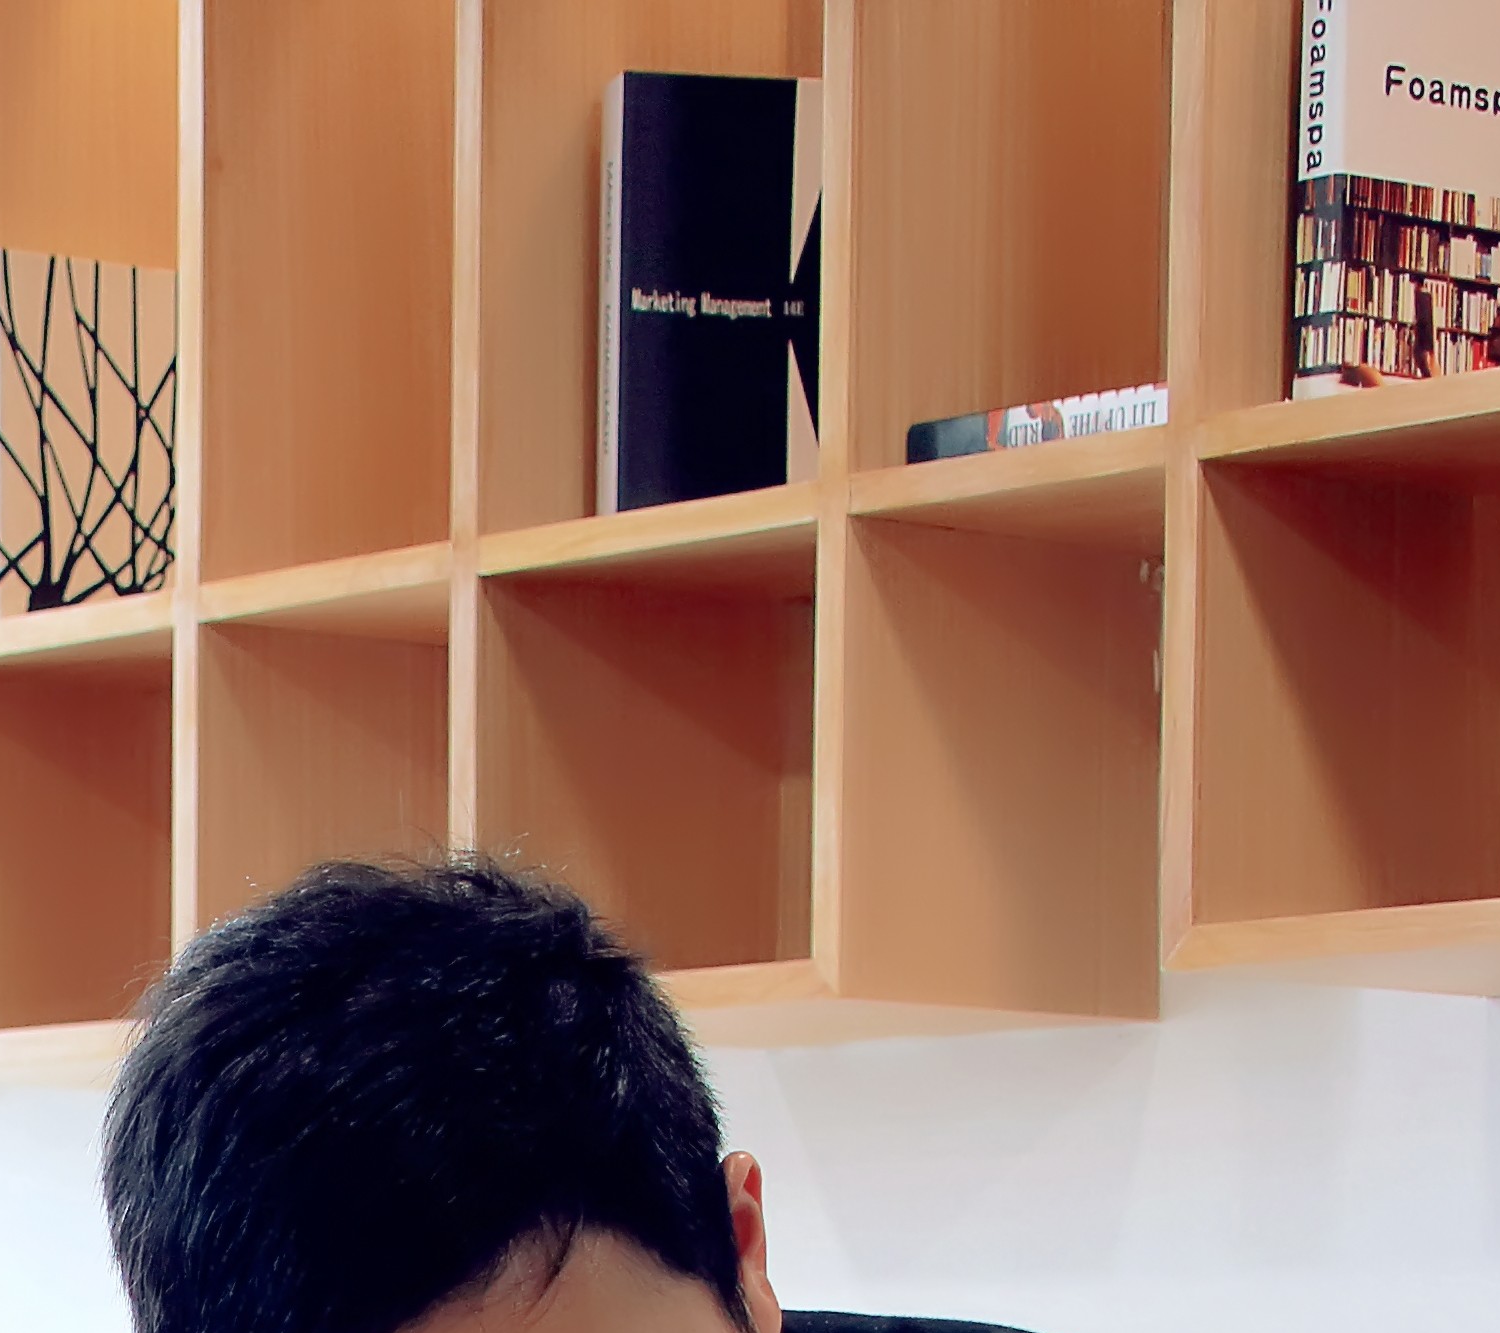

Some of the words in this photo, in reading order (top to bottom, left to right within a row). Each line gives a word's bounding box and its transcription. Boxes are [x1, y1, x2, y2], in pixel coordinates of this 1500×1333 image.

[631, 287, 697, 318] Marketing
[700, 291, 773, 320] Management
[1071, 412, 1101, 437] THE
[1103, 406, 1126, 430] UP
[1127, 400, 1157, 426] LIT
